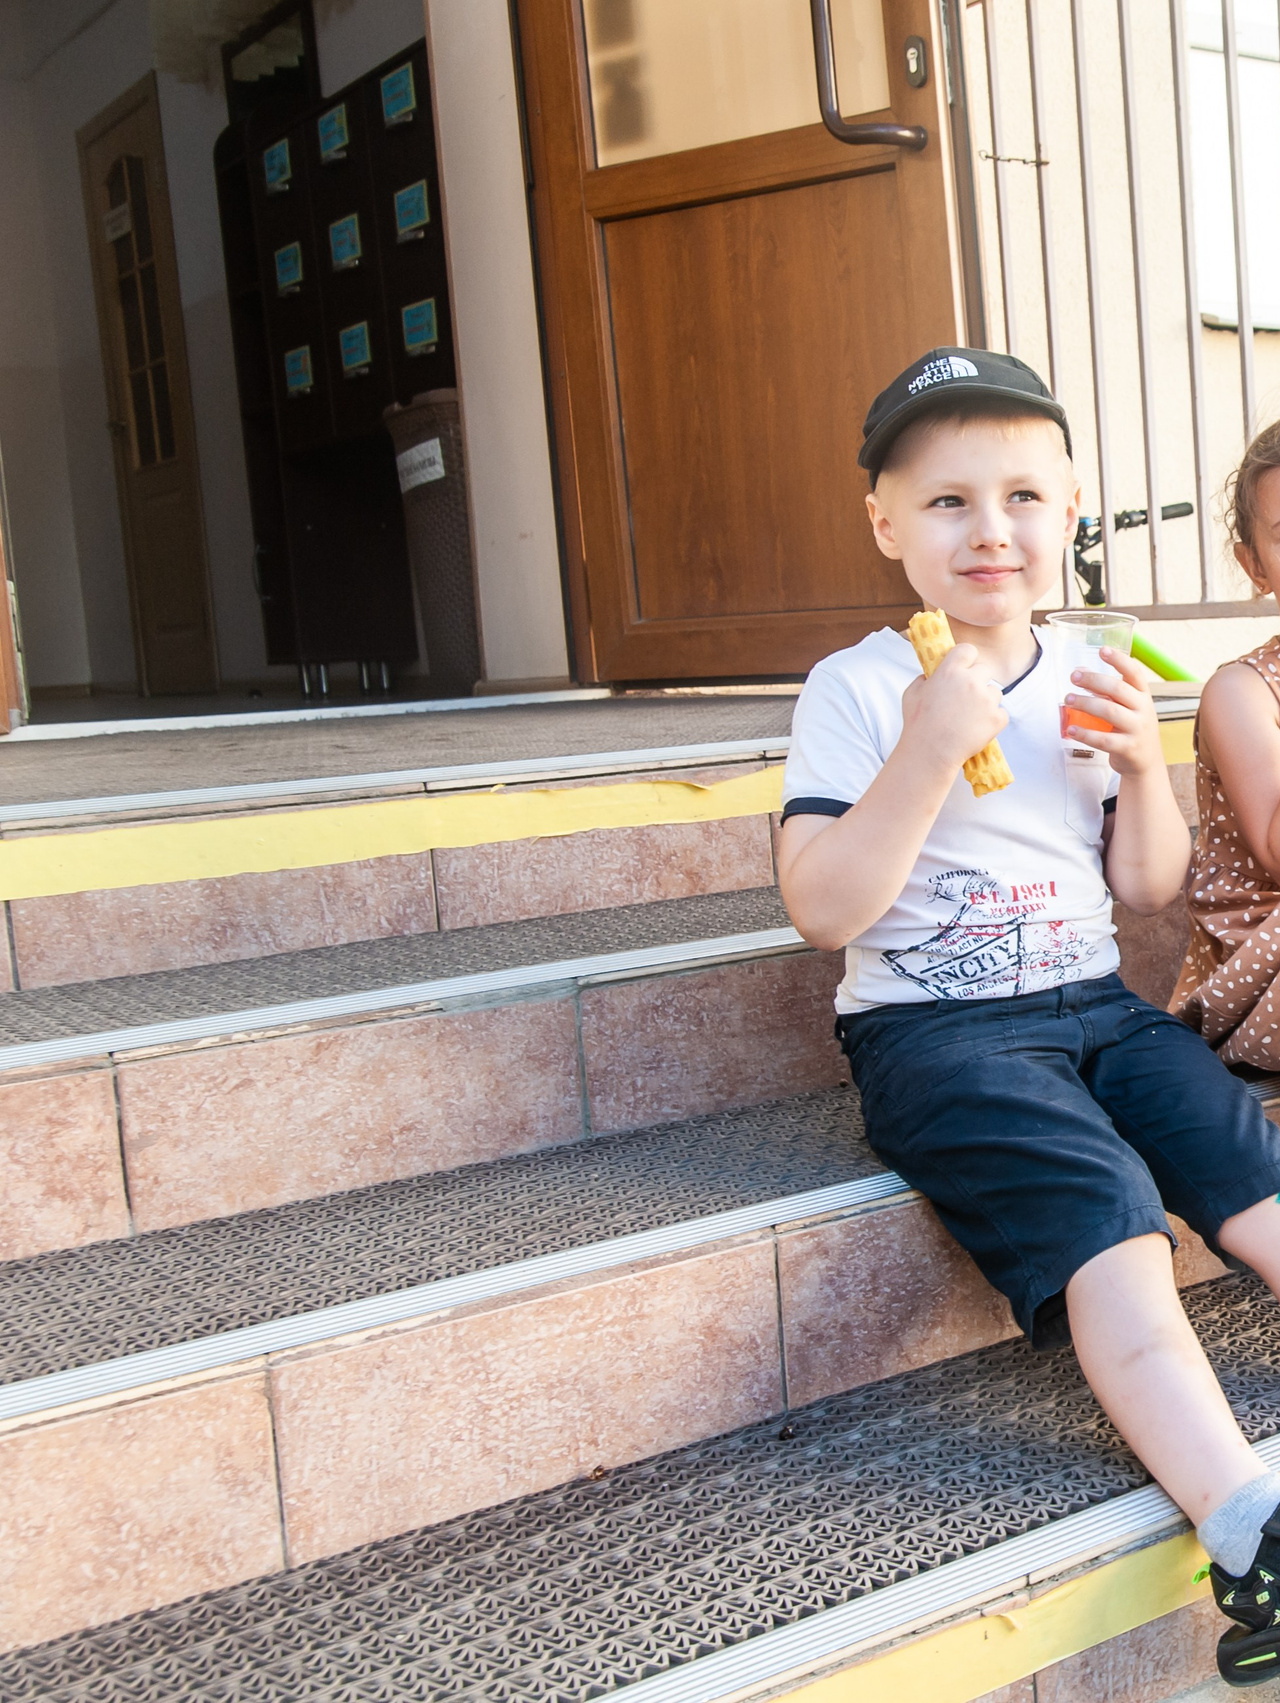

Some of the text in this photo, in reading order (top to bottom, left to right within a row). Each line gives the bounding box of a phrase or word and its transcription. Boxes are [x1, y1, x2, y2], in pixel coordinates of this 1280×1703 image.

[923, 357, 949, 372] THE
[908, 364, 951, 392] NORTH
[917, 372, 953, 390] FACE
[1010, 881, 1058, 903] 1981
[957, 986, 975, 999] LOS
